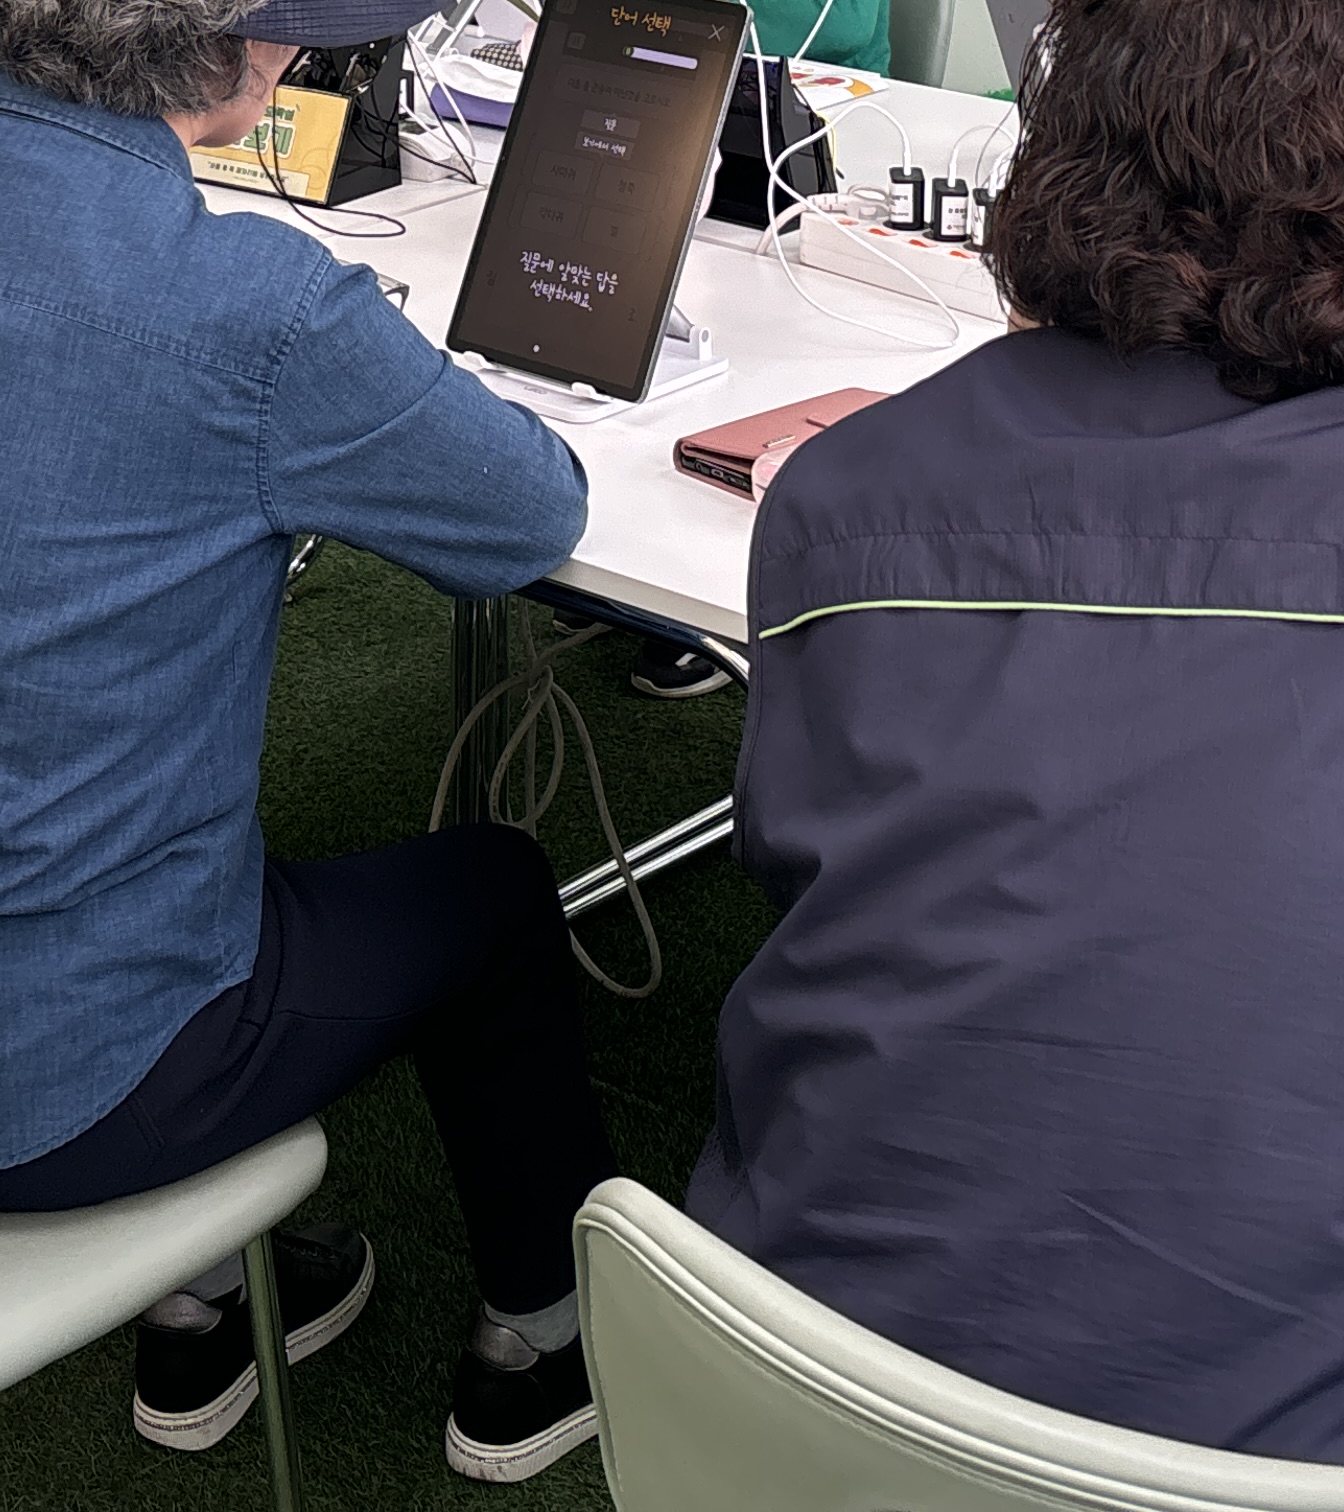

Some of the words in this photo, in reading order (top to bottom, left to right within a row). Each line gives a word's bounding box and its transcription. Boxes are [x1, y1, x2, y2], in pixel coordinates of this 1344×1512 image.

[610, 6, 639, 28] 단어
[642, 11, 671, 37] 선택
[519, 250, 554, 276] 질문에
[558, 262, 592, 287] 알맞는
[596, 270, 620, 295] 답을
[529, 279, 594, 313] 선택하세요.
